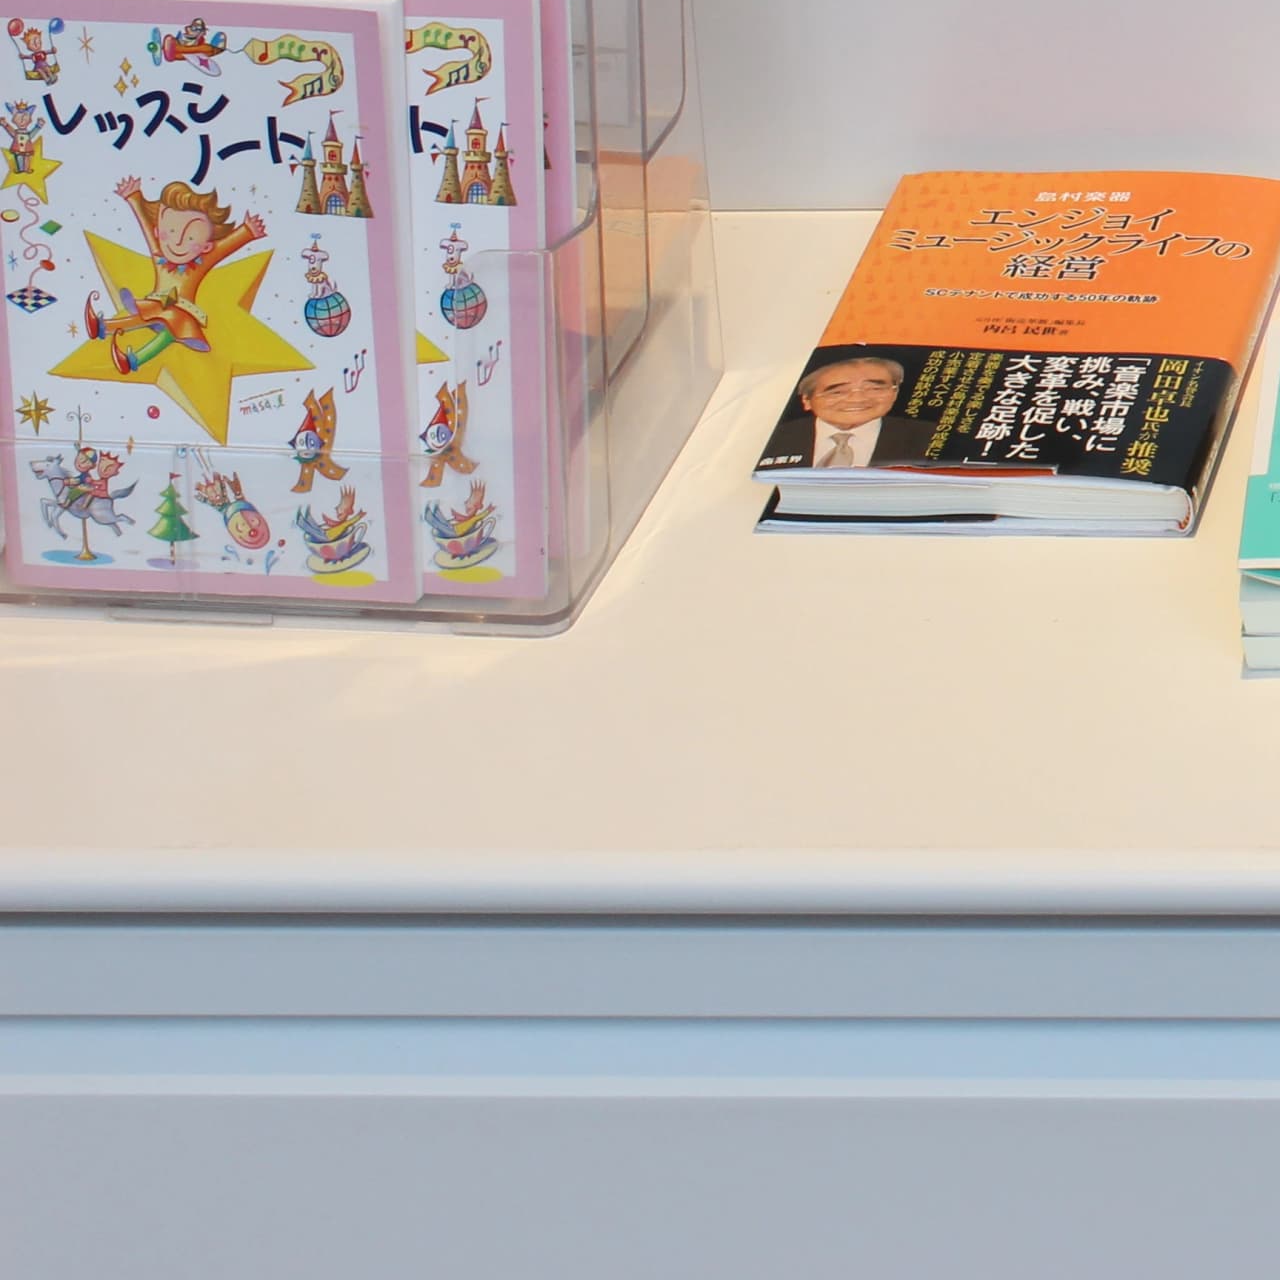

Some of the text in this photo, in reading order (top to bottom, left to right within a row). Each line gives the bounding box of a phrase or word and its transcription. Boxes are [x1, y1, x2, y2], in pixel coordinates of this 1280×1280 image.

[43, 83, 229, 149] レッスン
[190, 117, 305, 184] ノート
[970, 207, 1175, 232] エンジョイ
[1034, 191, 1132, 202] 島村楽器
[888, 228, 1252, 260] ミュージックライフの
[1000, 254, 1106, 281] 経営
[1005, 356, 1079, 460] 変革を促した
[1085, 357, 1151, 452] 「音楽市場に
[1120, 358, 1190, 475] 岡田卓也氏が推奨
